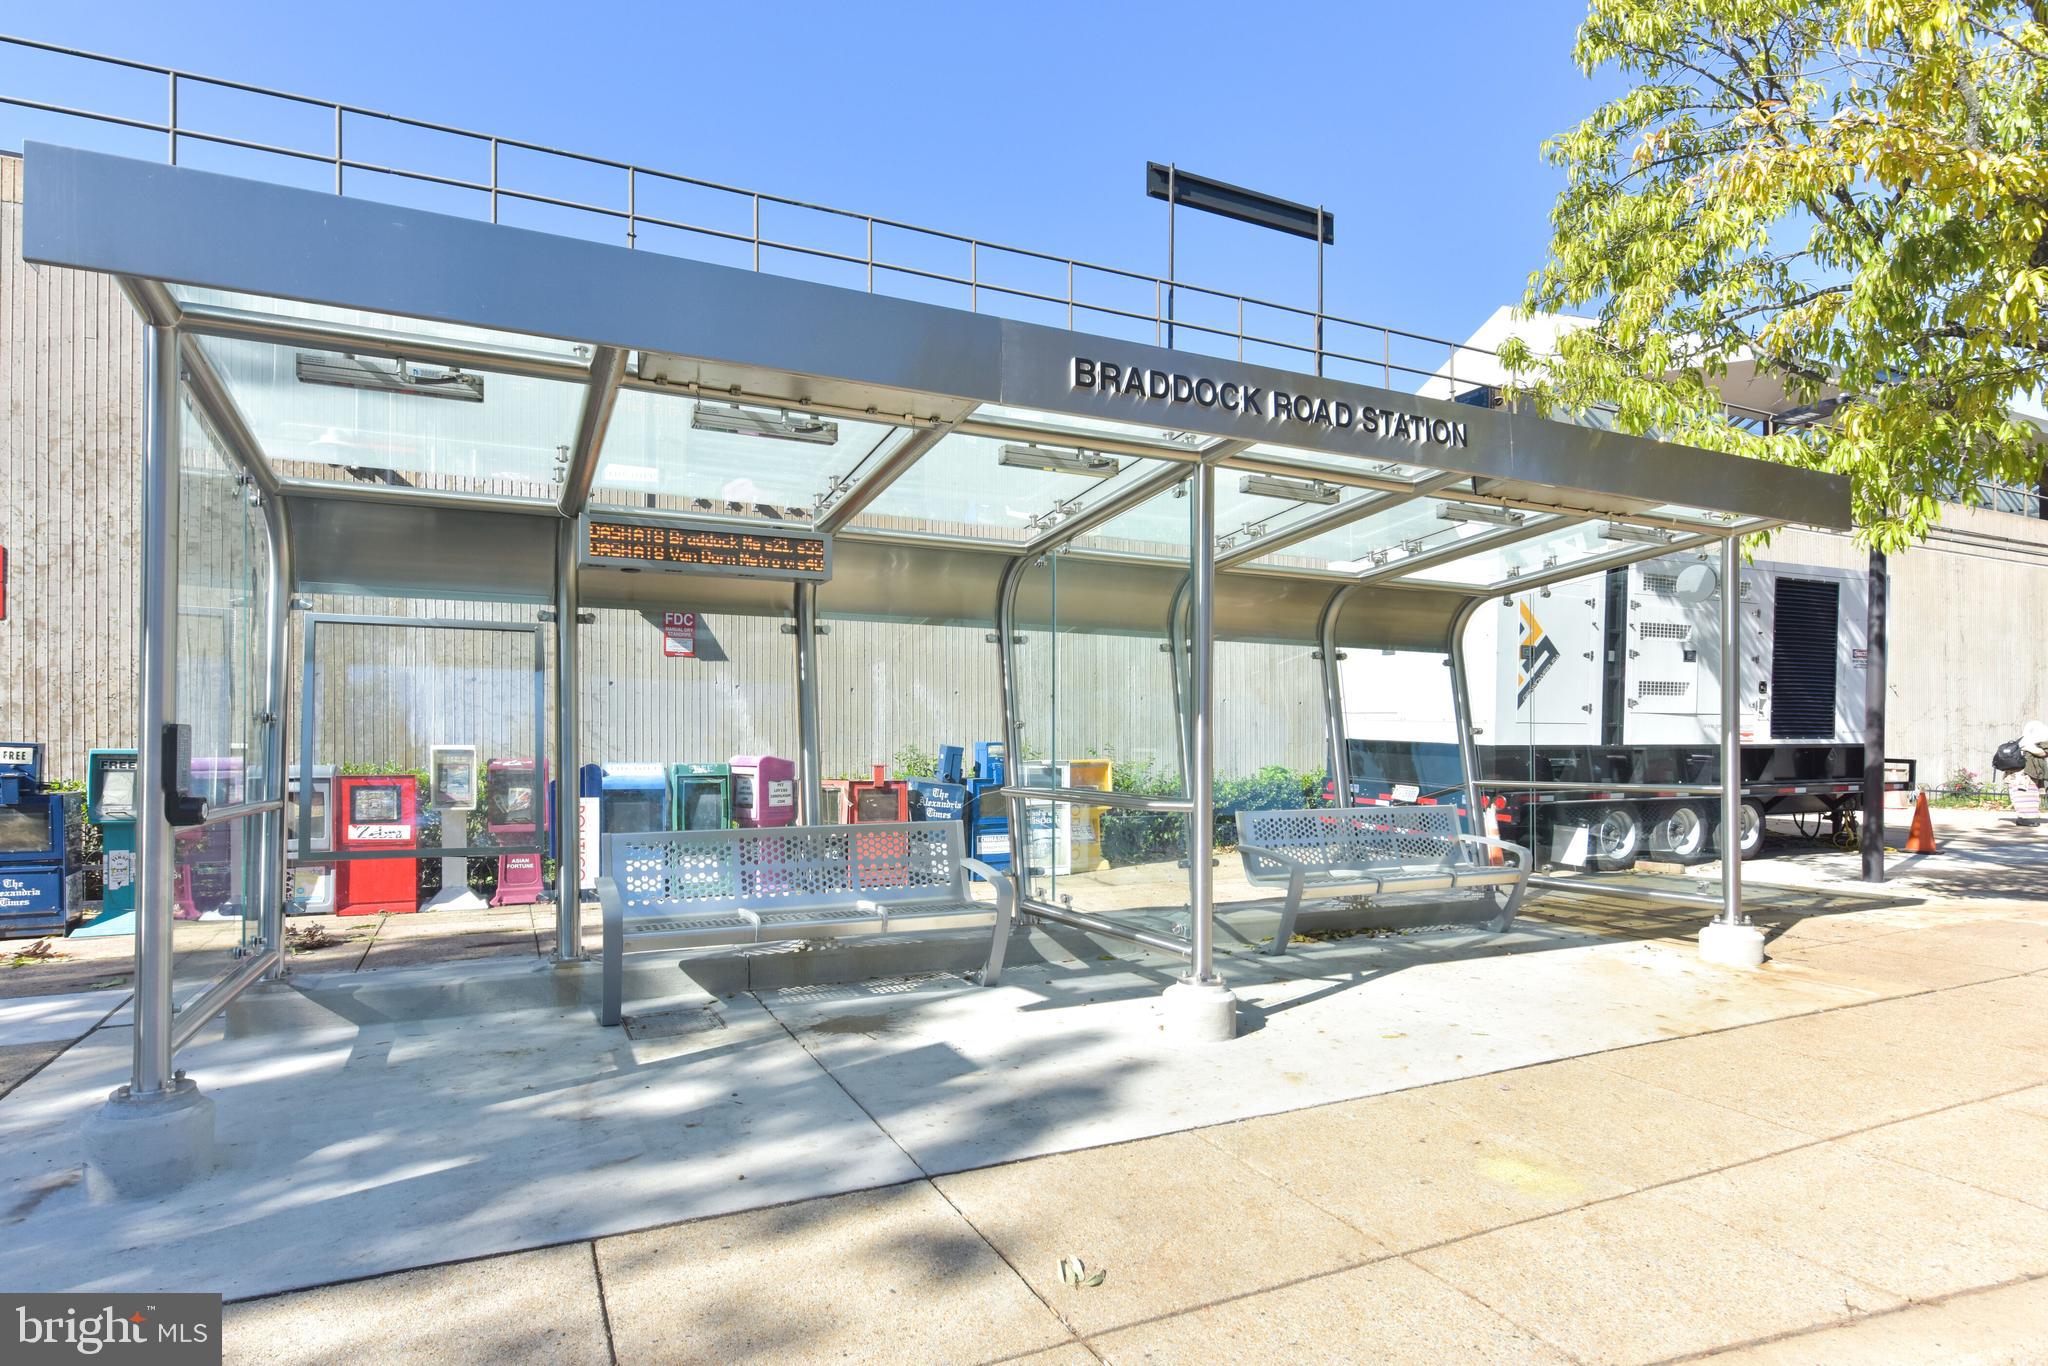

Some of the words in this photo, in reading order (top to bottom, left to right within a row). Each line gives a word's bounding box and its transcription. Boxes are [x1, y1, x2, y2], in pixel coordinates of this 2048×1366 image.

[1071, 356, 1263, 416] BRADDOCK
[1268, 390, 1354, 429] ROAD
[1361, 405, 1469, 448] STATION
[740, 552, 781, 569] Metro
[665, 612, 694, 626] FDC
[3, 751, 27, 761] FREE
[100, 760, 138, 770] FREE
[932, 787, 950, 801] The
[917, 796, 962, 809] Alexandria
[926, 807, 952, 819] Times
[2, 878, 24, 890] The
[0, 887, 41, 897] exandria
[0, 897, 30, 907] Times
